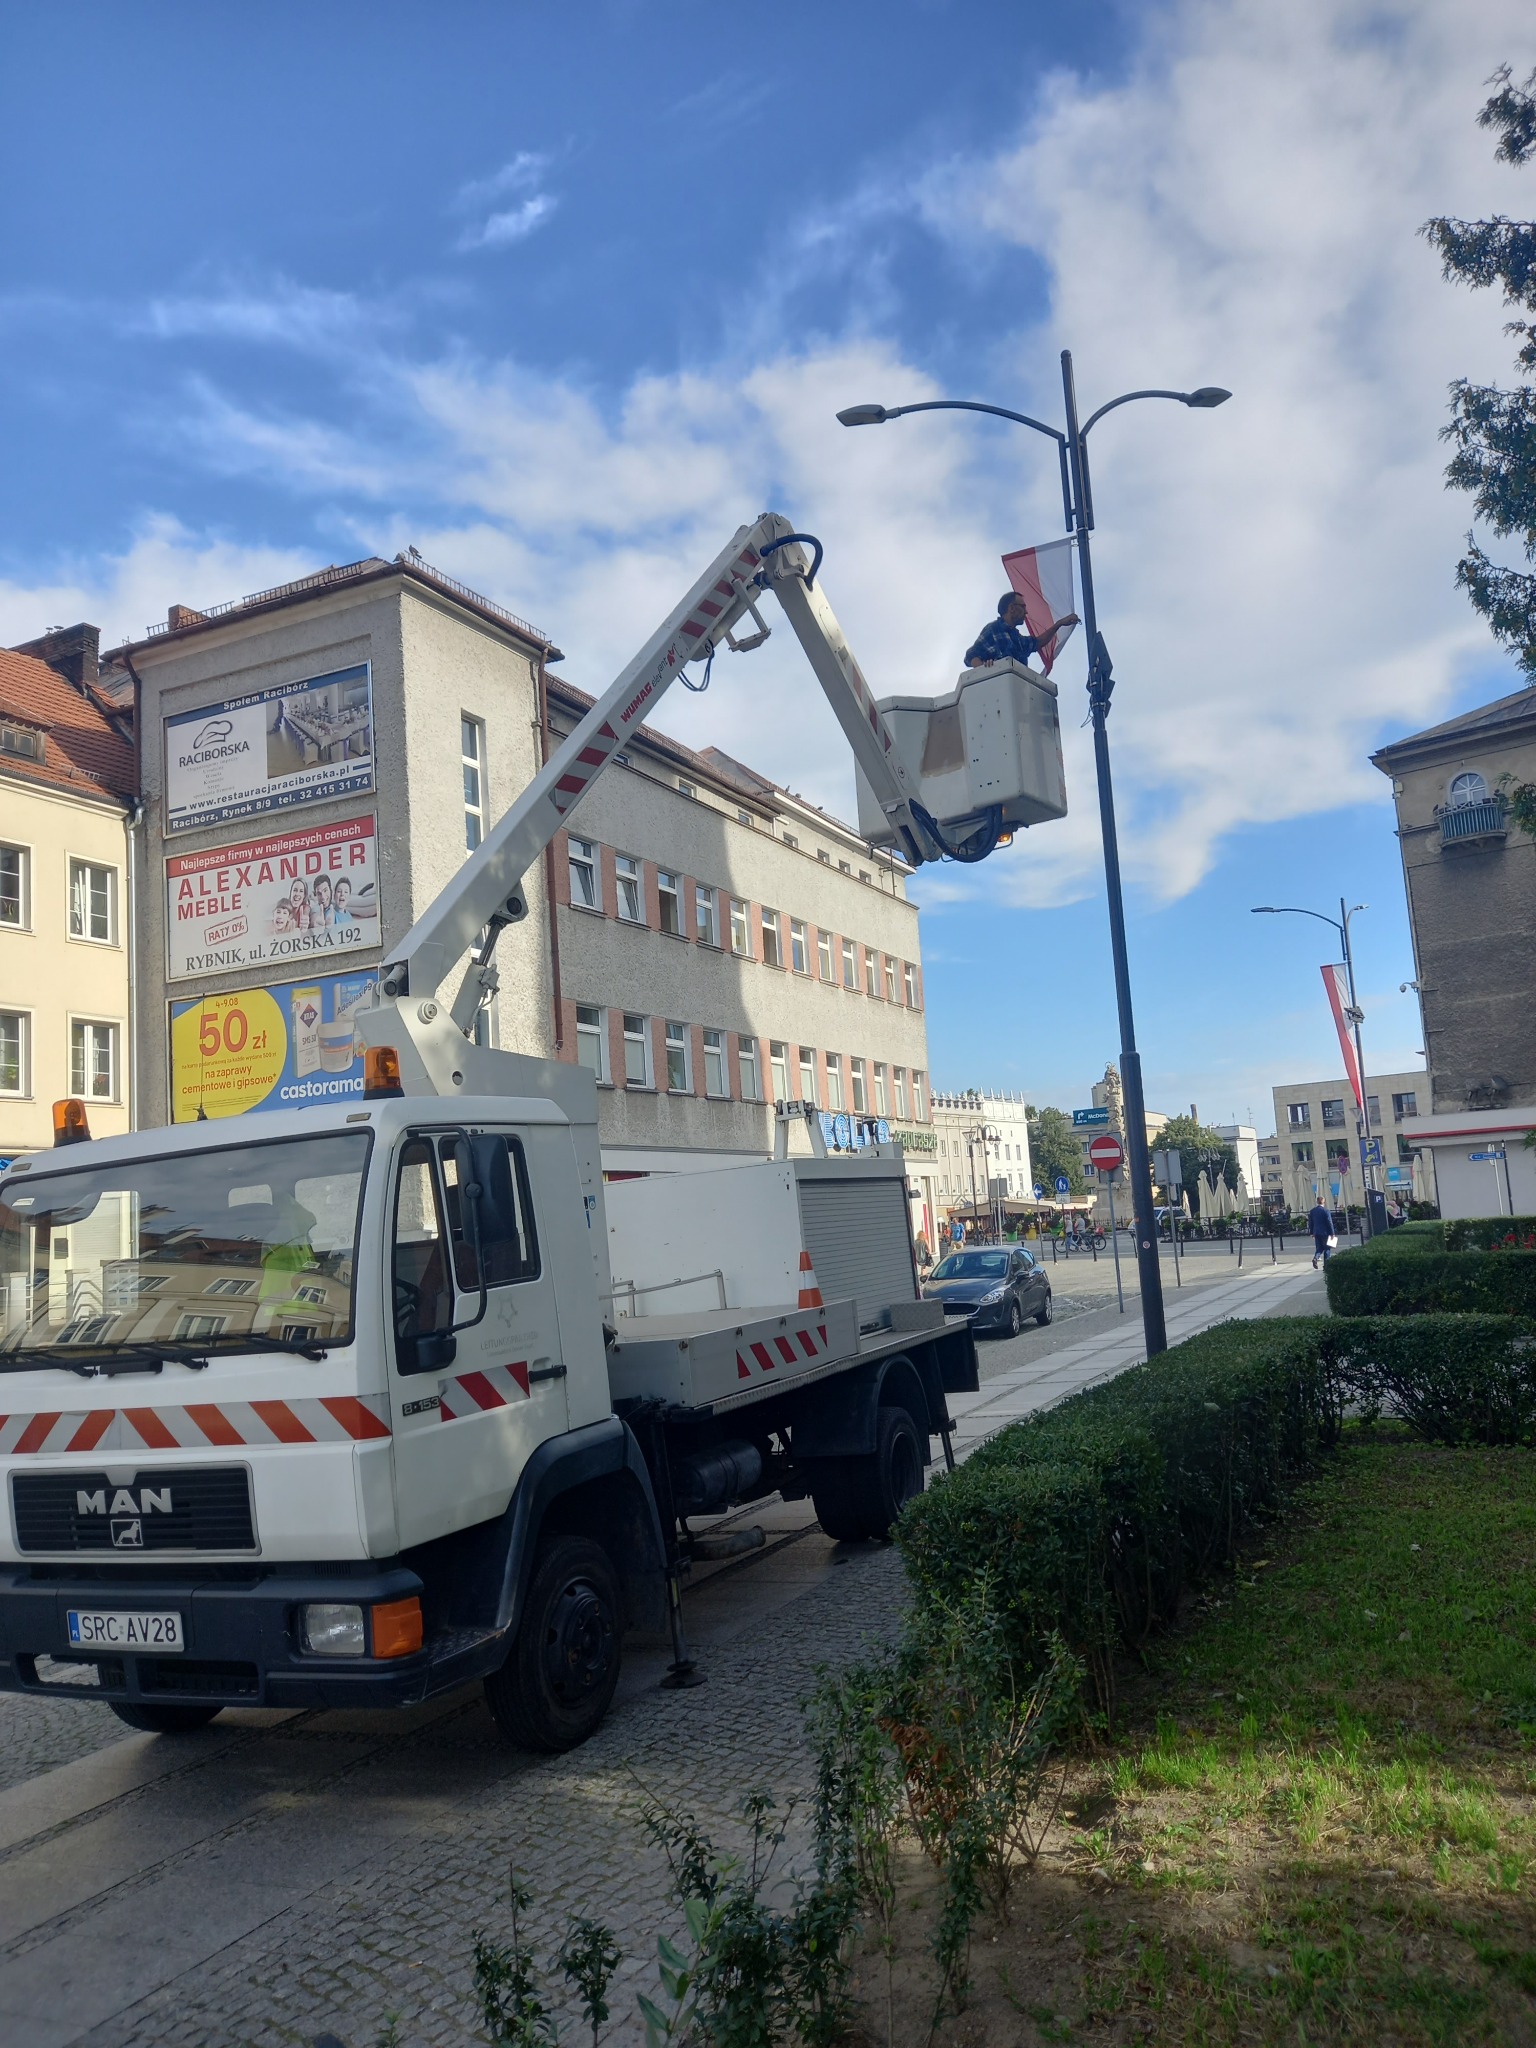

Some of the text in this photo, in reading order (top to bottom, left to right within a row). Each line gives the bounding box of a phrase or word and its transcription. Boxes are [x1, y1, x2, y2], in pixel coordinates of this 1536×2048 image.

[223, 681, 309, 711] Społem Racibórz
[620, 681, 653, 723] WUMAG
[179, 740, 250, 767] RACIBORSKA
[189, 765, 350, 811] www.restauracjaraciborska.pl
[172, 776, 369, 829] Racibórz, Rynek 8/9 tel. 32 415 31 74
[180, 823, 361, 871] Najlepsze firmy w najlepszych cenach
[178, 842, 366, 900] ALEXANDER
[177, 893, 242, 921] MEBLE
[208, 922, 245, 942] RATY 0%
[185, 927, 361, 971] RYBNIK, ul. ŻORSKA 192
[215, 997, 239, 1008] 4-9.08
[199, 1009, 248, 1056] 50
[252, 1030, 267, 1050] zł
[205, 1066, 252, 1079] na zaprawy
[182, 1081, 231, 1094] cementowe
[280, 1077, 364, 1100] castorama
[1365, 1141, 1375, 1152] P
[1375, 1195, 1381, 1203] P
[76, 1488, 173, 1515] MAN
[82, 1616, 177, 1643] SRC AV28
